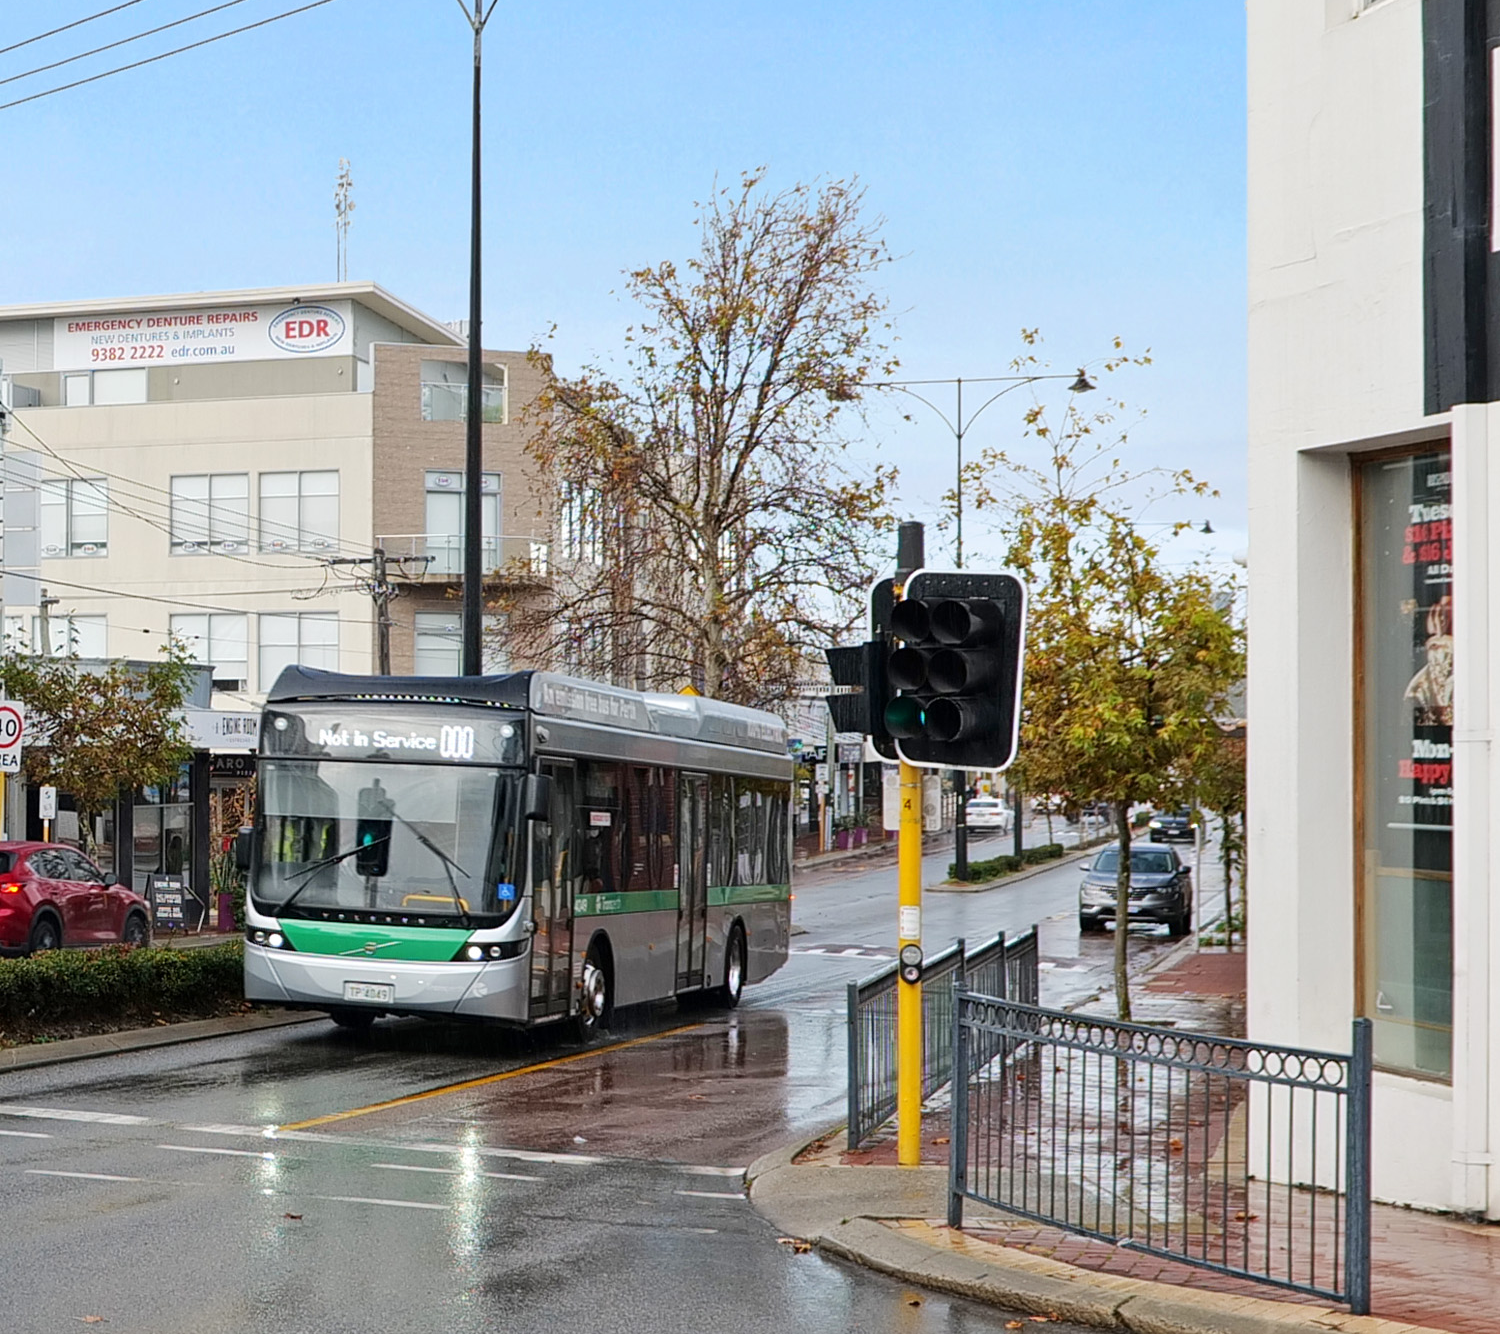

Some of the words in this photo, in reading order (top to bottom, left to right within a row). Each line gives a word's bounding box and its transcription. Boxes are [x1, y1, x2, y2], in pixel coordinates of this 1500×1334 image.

[68, 318, 144, 334] EMERGENCY
[147, 314, 204, 329] DENTURE
[207, 311, 259, 325] REPAIRS
[284, 319, 331, 339] EDR
[90, 334, 115, 345] NEW
[117, 331, 170, 345] DENTURES
[173, 329, 180, 340] &
[182, 327, 235, 340] IMPLANTS
[91, 346, 125, 362] 9382
[130, 344, 164, 360] 2222
[171, 344, 235, 359] edr.com.au
[319, 729, 349, 747] Not
[353, 730, 368, 747] in
[373, 730, 436, 750] Service
[1398, 759, 1451, 785] Happy
[904, 798, 912, 811] 4
